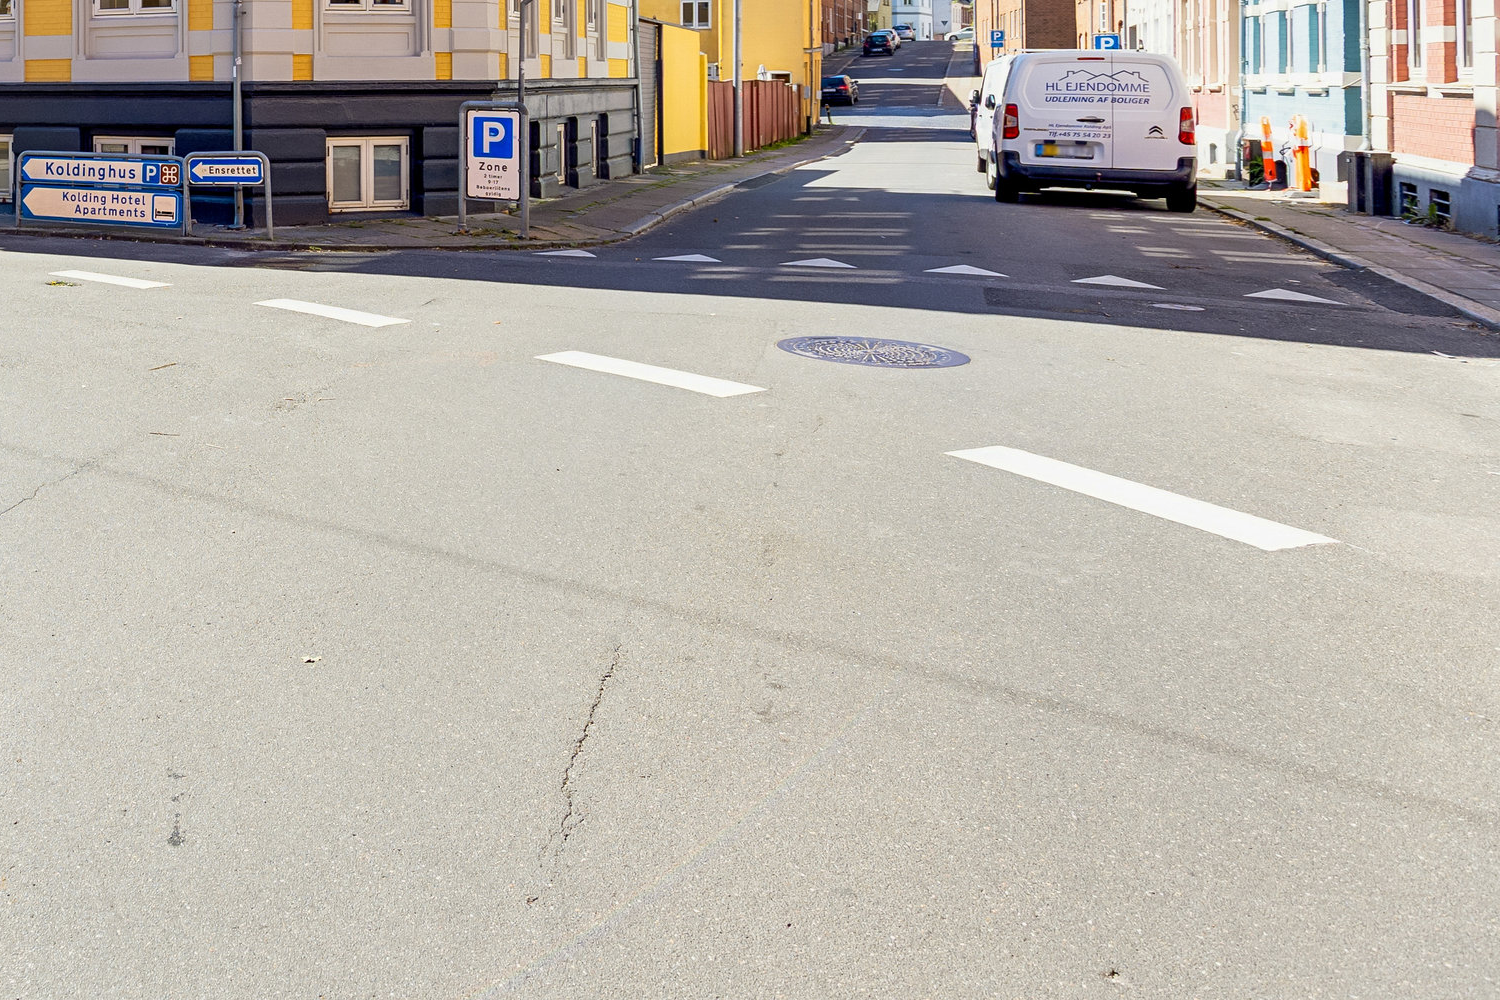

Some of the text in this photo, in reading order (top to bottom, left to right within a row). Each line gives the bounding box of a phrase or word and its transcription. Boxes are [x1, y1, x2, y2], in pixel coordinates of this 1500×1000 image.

[1045, 82, 1150, 93] HL EJENDOMME
[1111, 97, 1150, 105] BOLIGER
[482, 121, 506, 154] P
[45, 162, 136, 181] Koldinghus
[208, 166, 257, 175] Ensrettet
[479, 162, 508, 172] Zone
[62, 191, 146, 206] Kolding Hotel
[74, 204, 146, 218] Apartments
